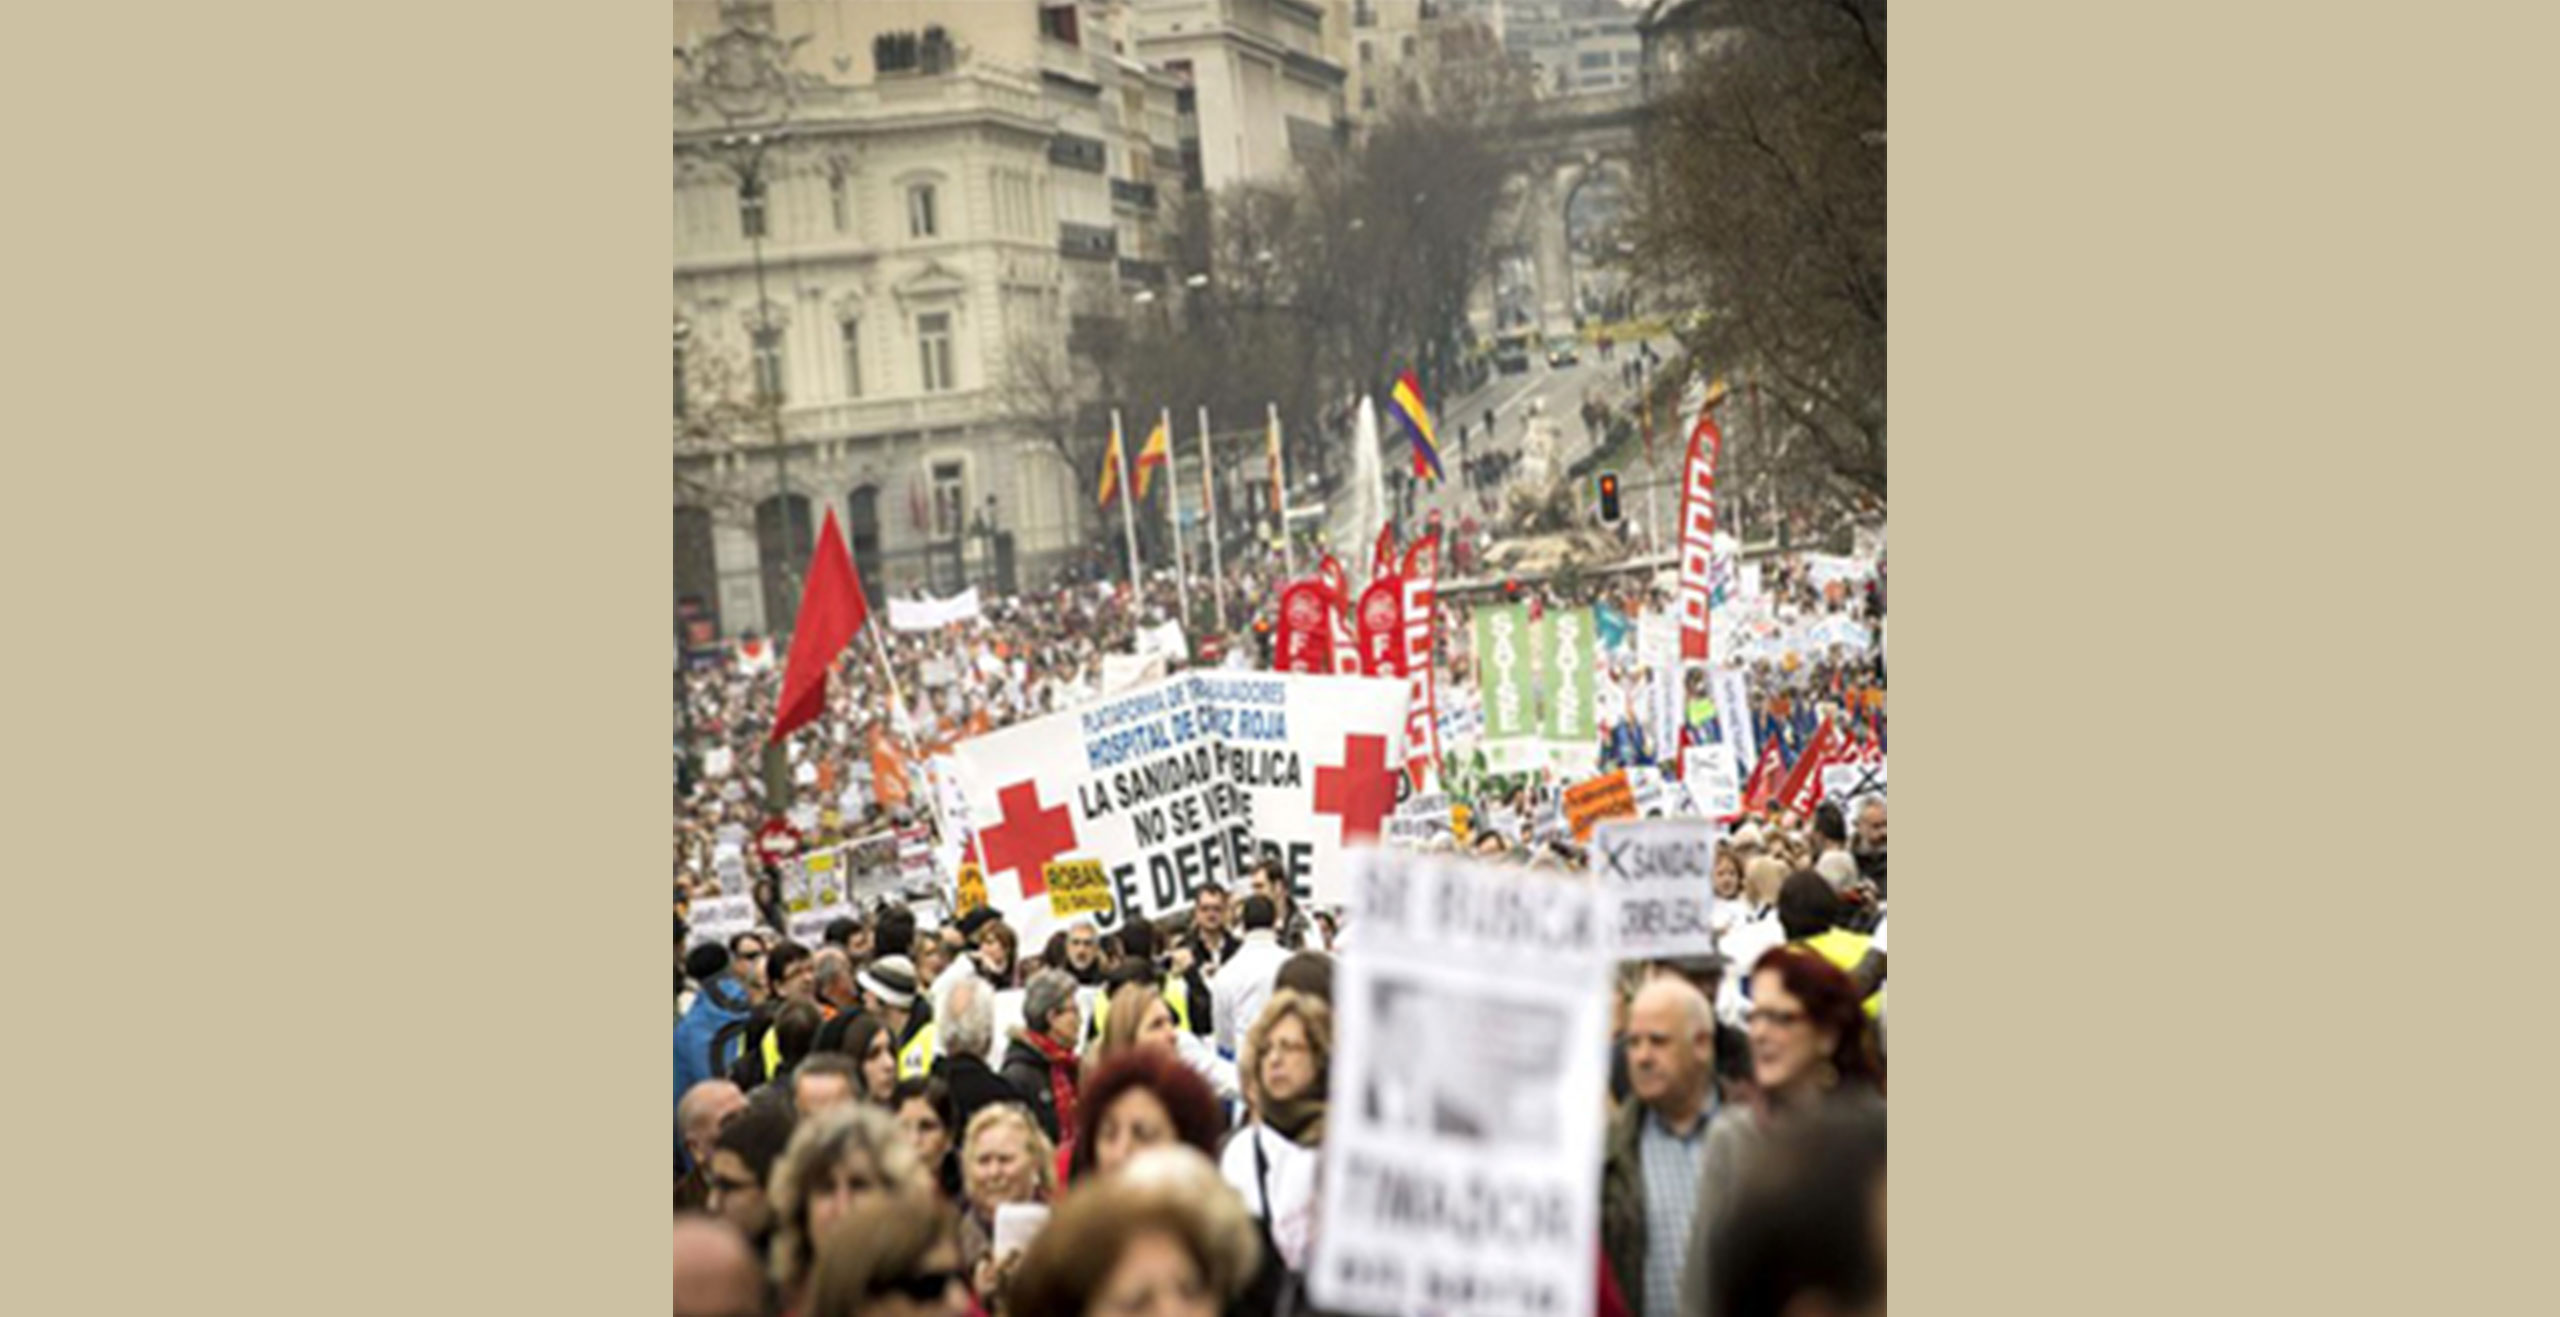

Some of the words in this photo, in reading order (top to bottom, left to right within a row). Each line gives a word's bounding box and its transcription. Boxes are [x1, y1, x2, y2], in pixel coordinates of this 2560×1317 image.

[1086, 719, 1171, 772] HOSPITAL
[1171, 709, 1196, 745] DE
[1238, 708, 1288, 742] ROJA
[1078, 779, 1113, 820] LA
[1113, 747, 1211, 809] SANIDAD
[1213, 741, 1302, 788] PBLICA
[1132, 806, 1167, 849] NO
[1170, 795, 1201, 837] SE
